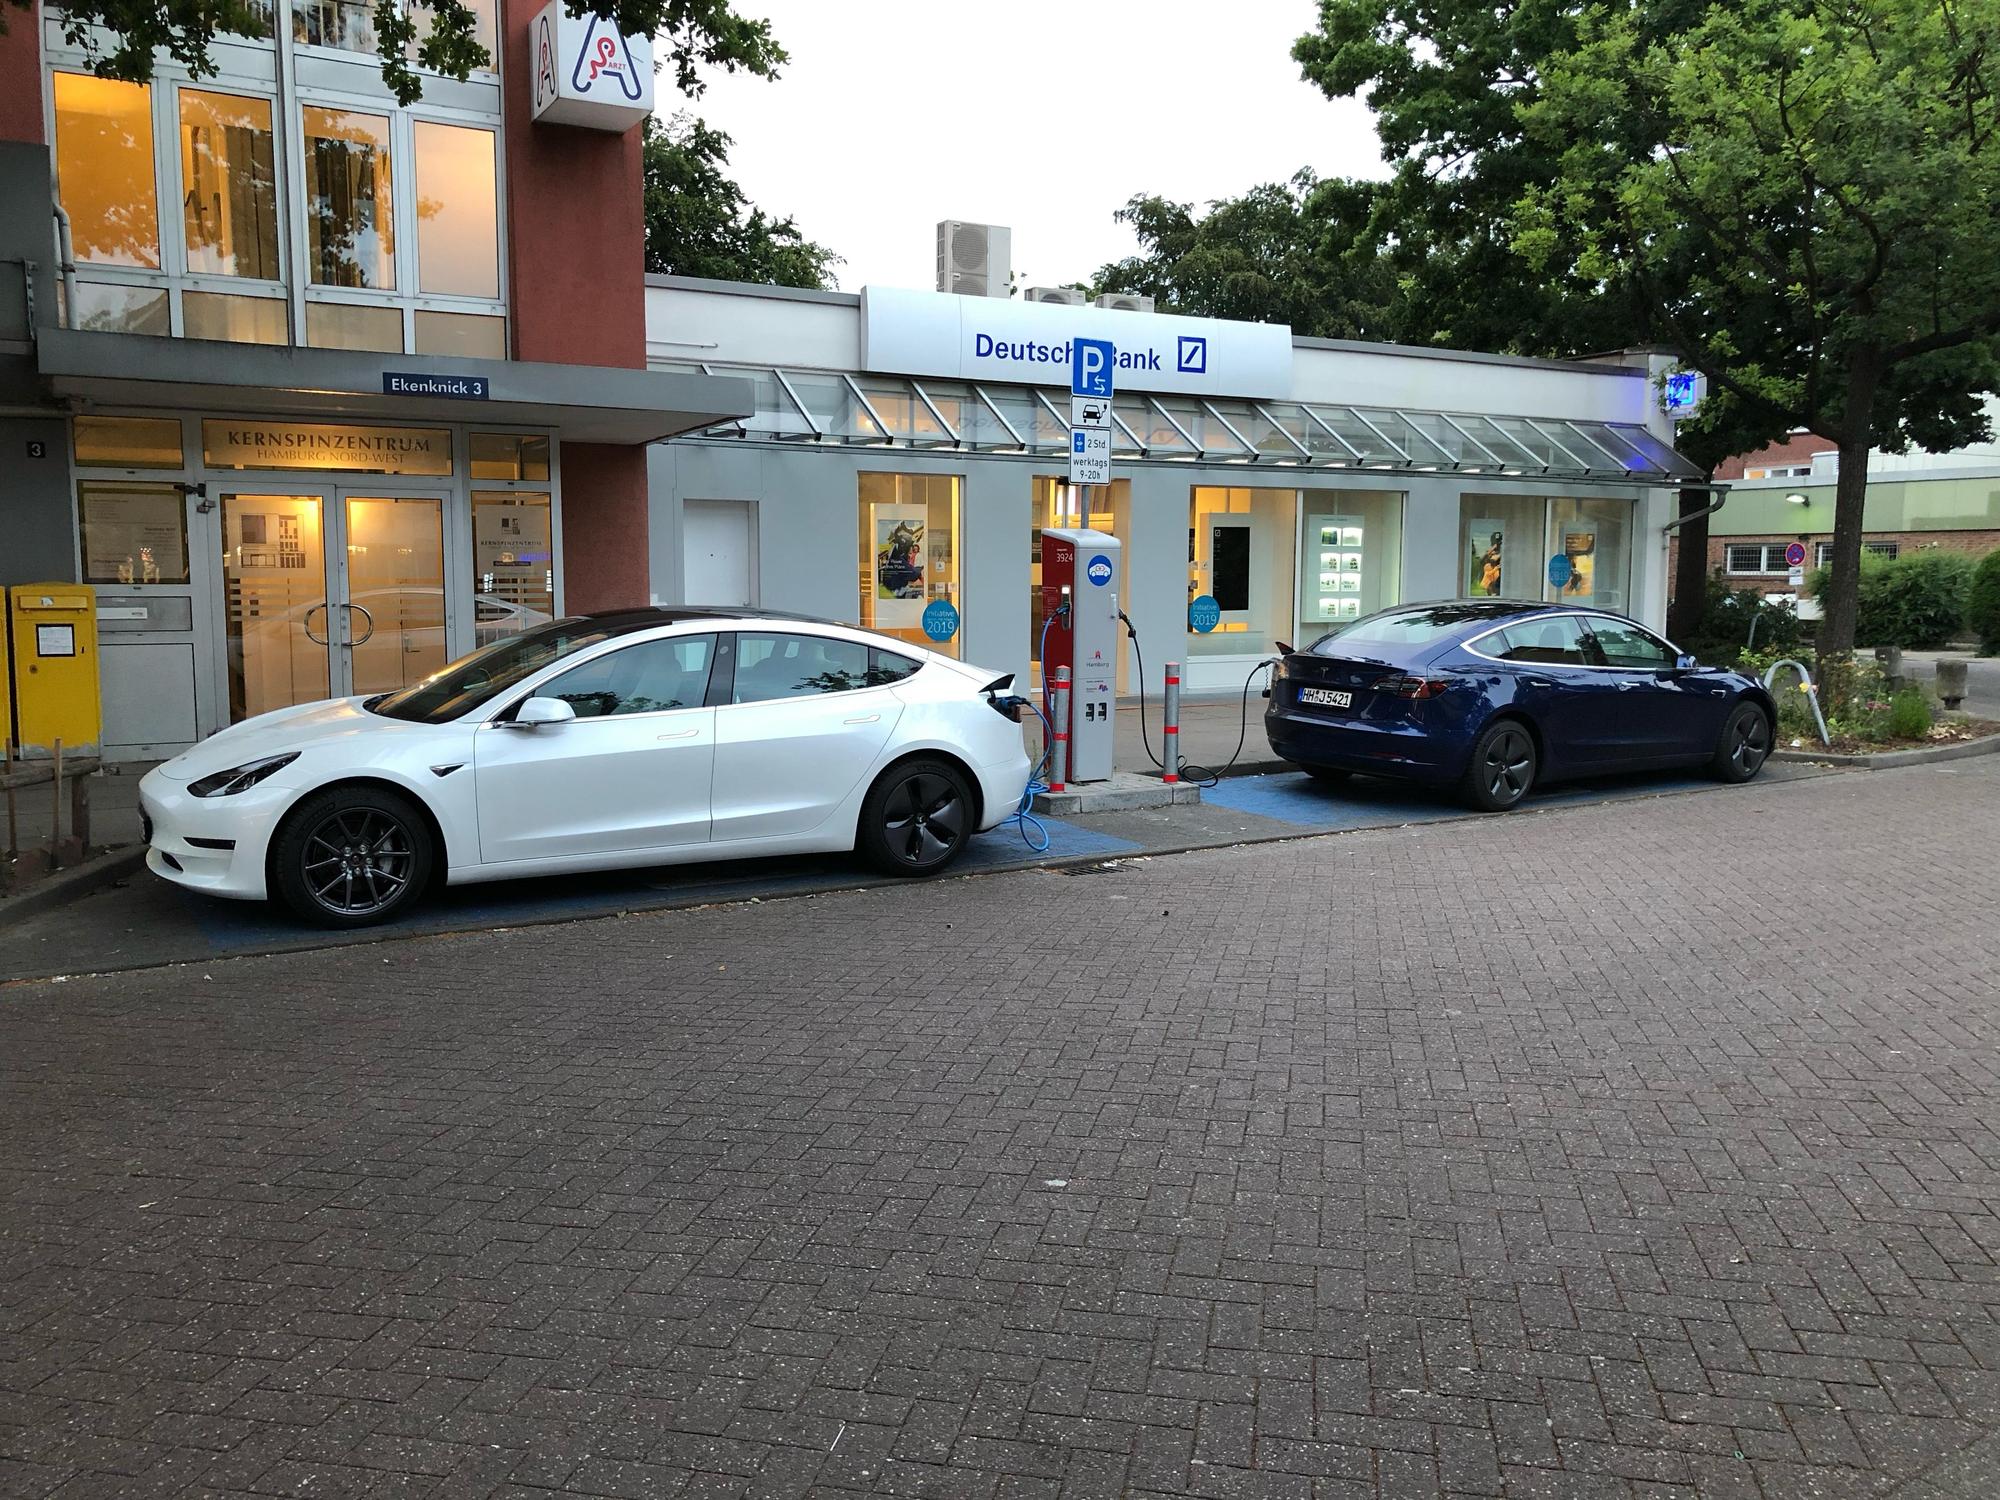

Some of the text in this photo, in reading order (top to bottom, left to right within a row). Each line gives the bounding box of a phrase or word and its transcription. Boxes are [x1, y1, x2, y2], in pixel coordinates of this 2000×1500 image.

[607, 61, 627, 71] ARZT
[975, 333, 1074, 365] Deutsch
[1081, 345, 1105, 389] P
[391, 378, 482, 395] Ekenknick 3
[228, 431, 430, 452] KERNSPINZENTRUM
[1087, 438, 1093, 448] 2
[31, 443, 41, 456] 3
[257, 449, 405, 464] HAMBURG NORD-WEST
[1073, 457, 1108, 470] werktags
[1080, 470, 1101, 480] 9-20h
[1056, 553, 1073, 563] 3924
[926, 610, 955, 618] Initiative
[1192, 614, 1218, 626] 2019
[926, 621, 955, 633] 2019
[1303, 689, 1315, 701] HH
